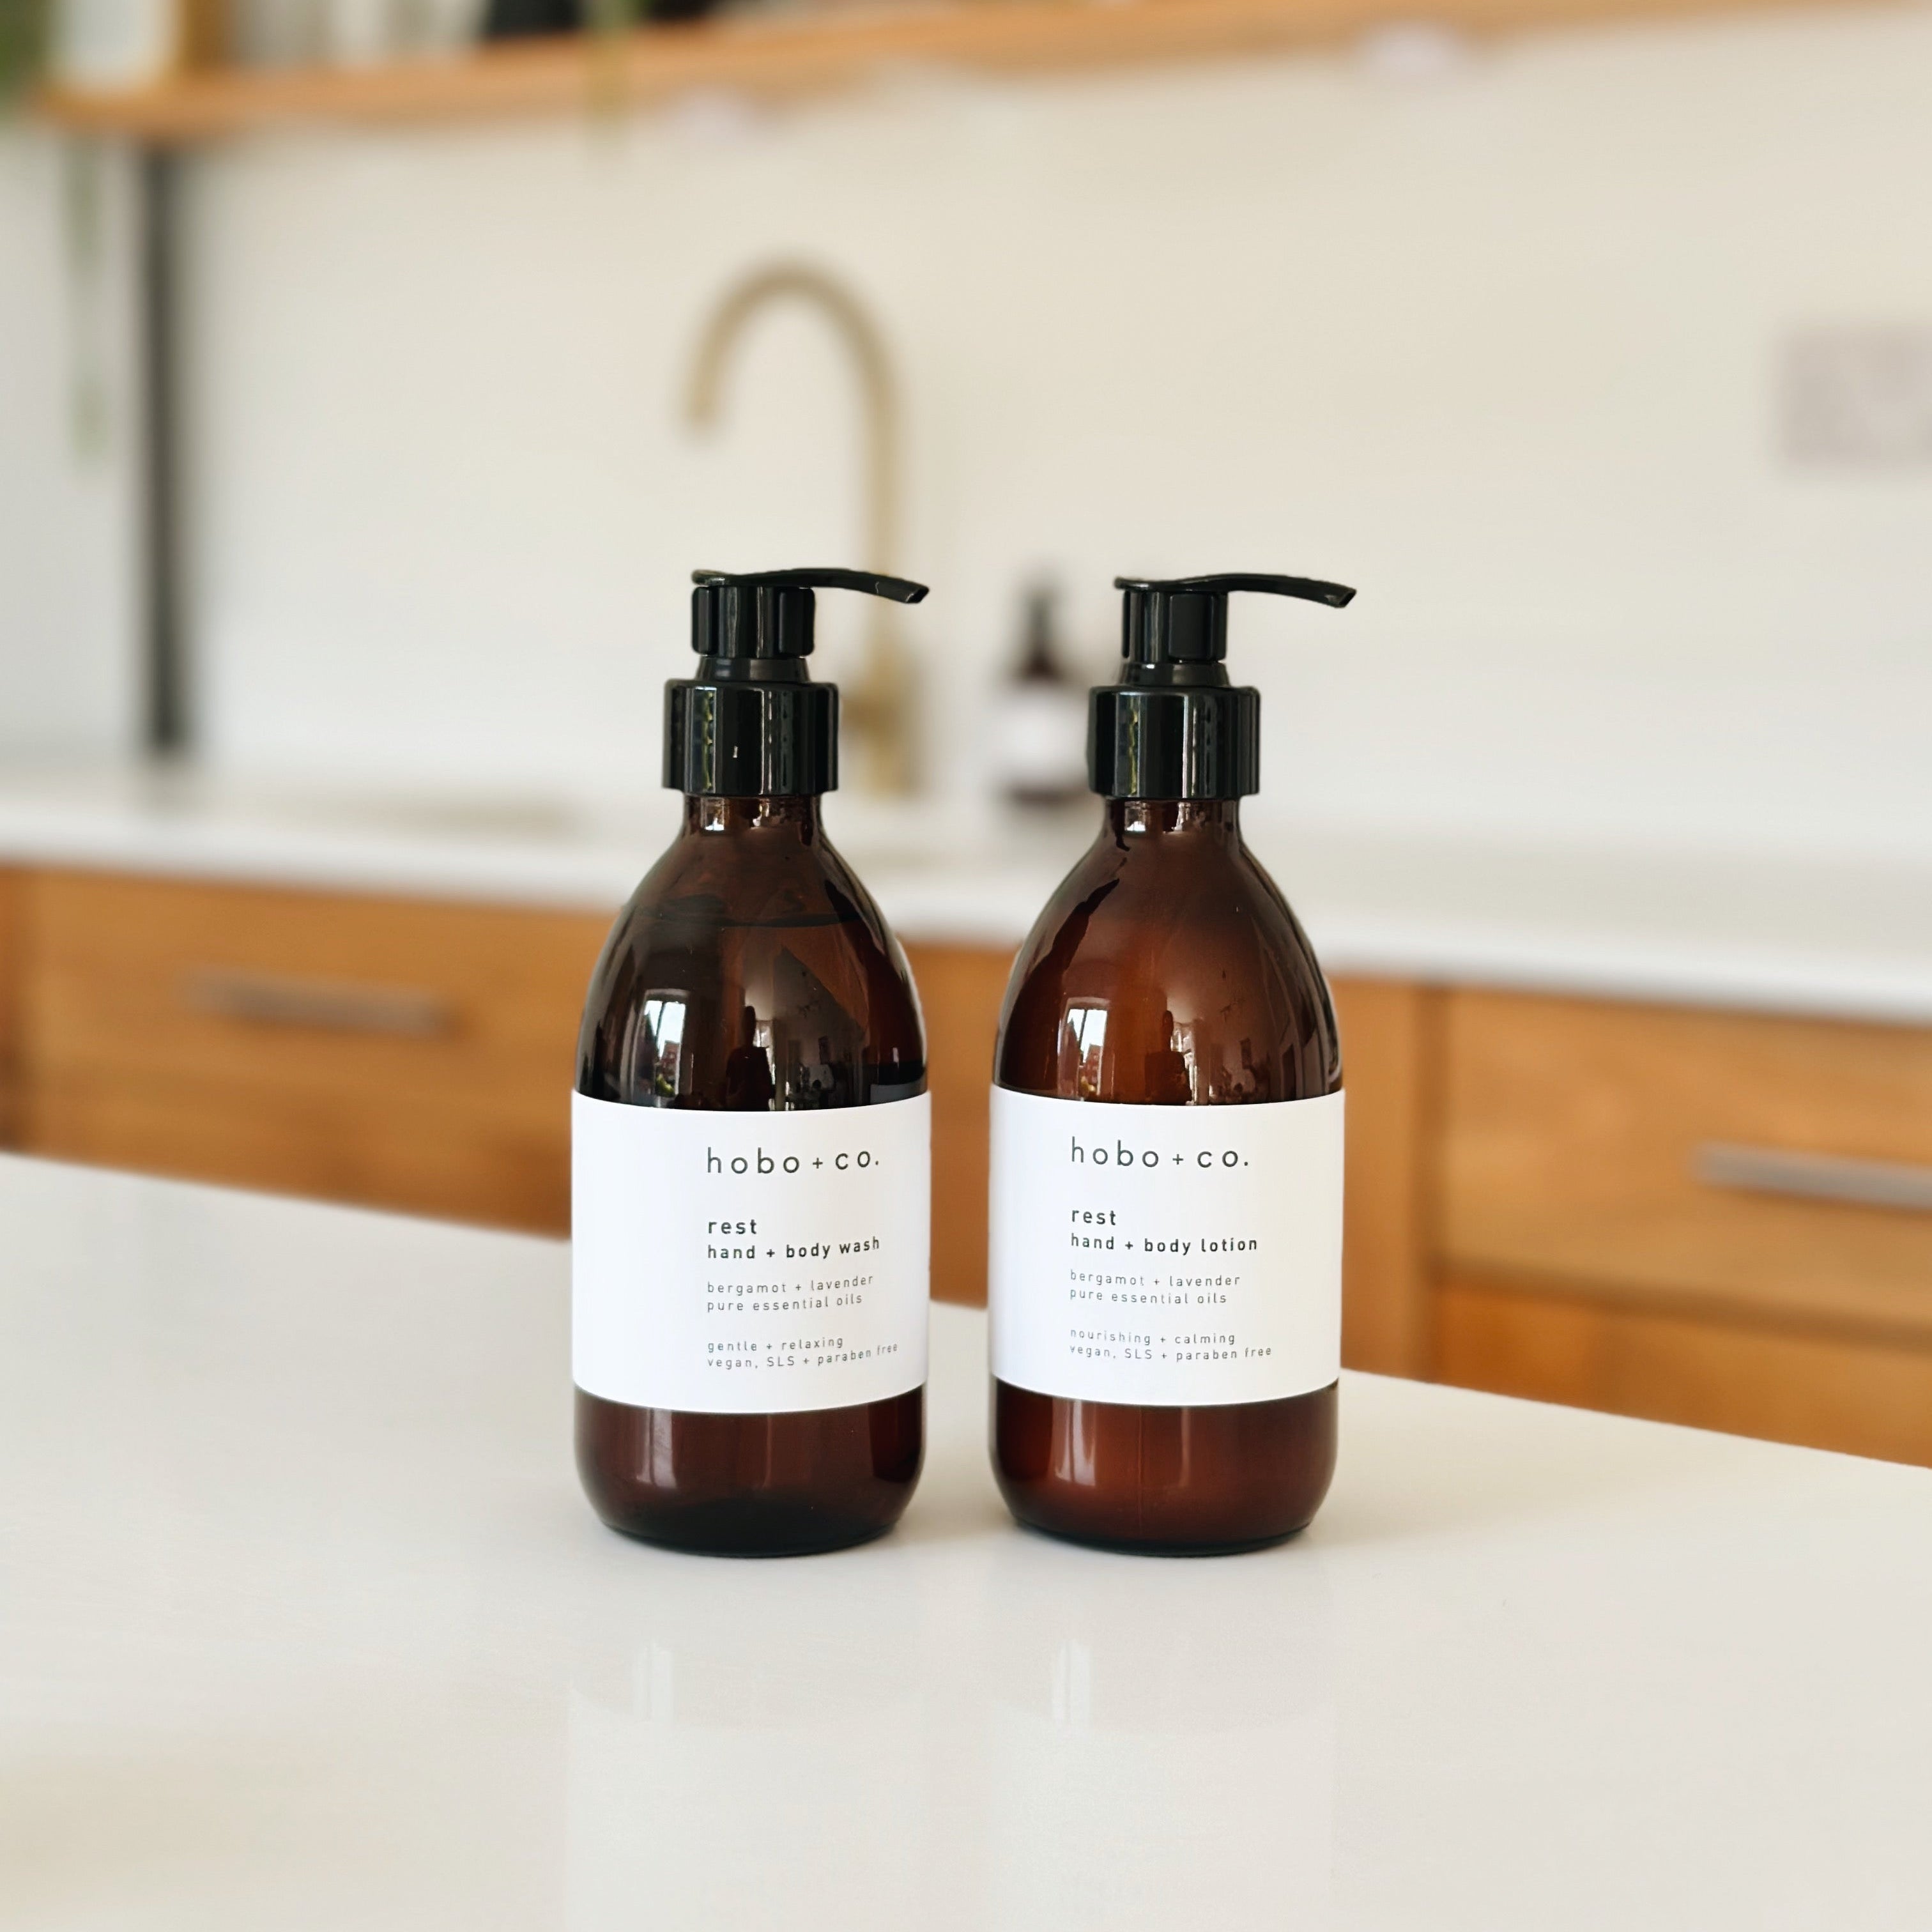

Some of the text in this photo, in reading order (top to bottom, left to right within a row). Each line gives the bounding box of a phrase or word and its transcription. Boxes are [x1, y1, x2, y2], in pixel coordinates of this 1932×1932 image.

[707, 1146, 879, 1174] hobo + co.
[1071, 1136, 1248, 1169] hobo + co.
[708, 1219, 757, 1235] rest
[1071, 1209, 1116, 1226] rest
[708, 1236, 880, 1260] hand + body wash
[1071, 1232, 1257, 1256] hand + body lotion
[707, 1281, 786, 1296] bergamot
[810, 1275, 873, 1292] lavender
[1070, 1269, 1144, 1287] bergamot
[1169, 1275, 1240, 1287] lavender
[707, 1292, 862, 1313] pure essential oils
[1070, 1289, 1227, 1304] pure essential oils
[707, 1340, 757, 1354] gentle
[781, 1337, 843, 1351] relaxing
[1070, 1329, 1151, 1346] nourishing
[1174, 1333, 1235, 1346] calming
[707, 1358, 758, 1370] vegan,
[766, 1355, 795, 1367] SLS
[816, 1348, 871, 1367] paraben
[877, 1343, 898, 1356] free
[1070, 1346, 1116, 1360] vegan,
[1124, 1347, 1153, 1360] SLS
[1176, 1349, 1238, 1363] paraben
[1245, 1347, 1271, 1358] free
